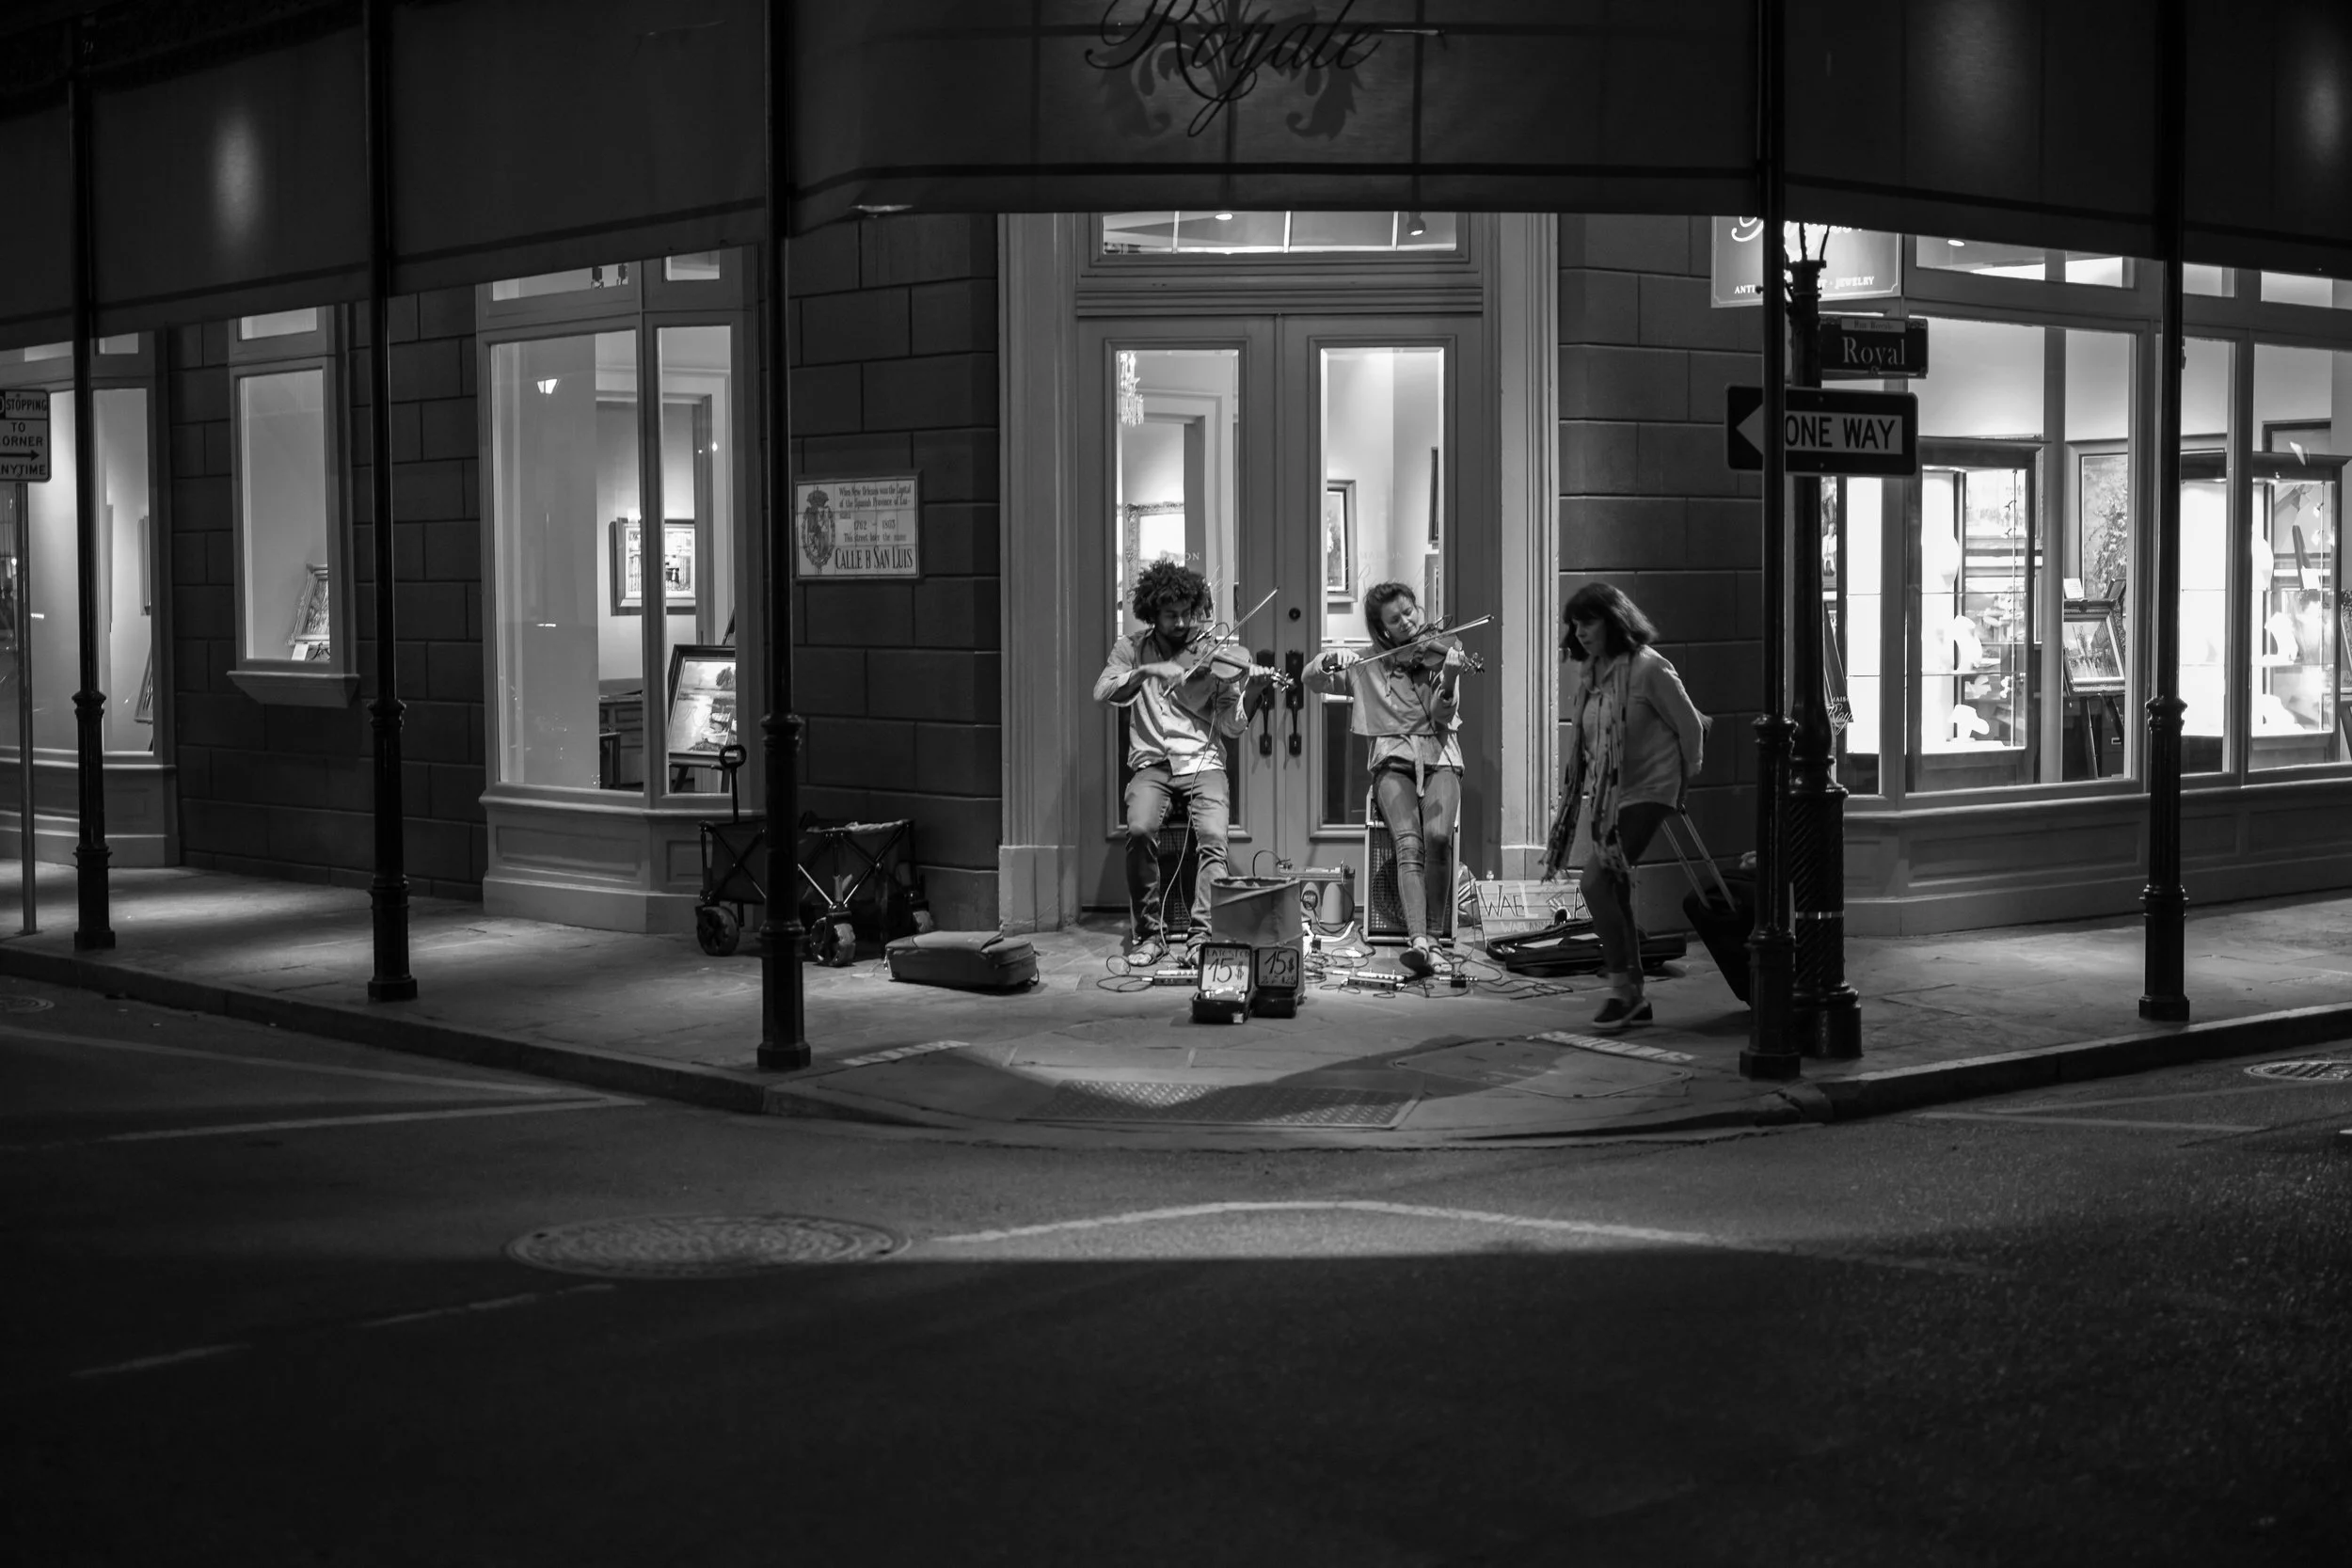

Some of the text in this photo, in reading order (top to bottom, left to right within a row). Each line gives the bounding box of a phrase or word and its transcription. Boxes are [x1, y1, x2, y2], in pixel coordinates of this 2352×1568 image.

[1085, 0, 1382, 137] Royale
[1835, 276, 1875, 289] JEWELRY
[1841, 336, 1905, 367] Royal
[6, 398, 48, 412] STOPPING
[10, 421, 26, 433] TO
[1785, 415, 1896, 450] ONE WAY
[2, 436, 43, 447] ORNER
[0, 464, 46, 477] NYTIME
[844, 532, 853, 542] This
[854, 532, 868, 543] street
[834, 547, 863, 570] CALLE
[873, 545, 890, 569] SAN
[892, 545, 913, 569] LUIS
